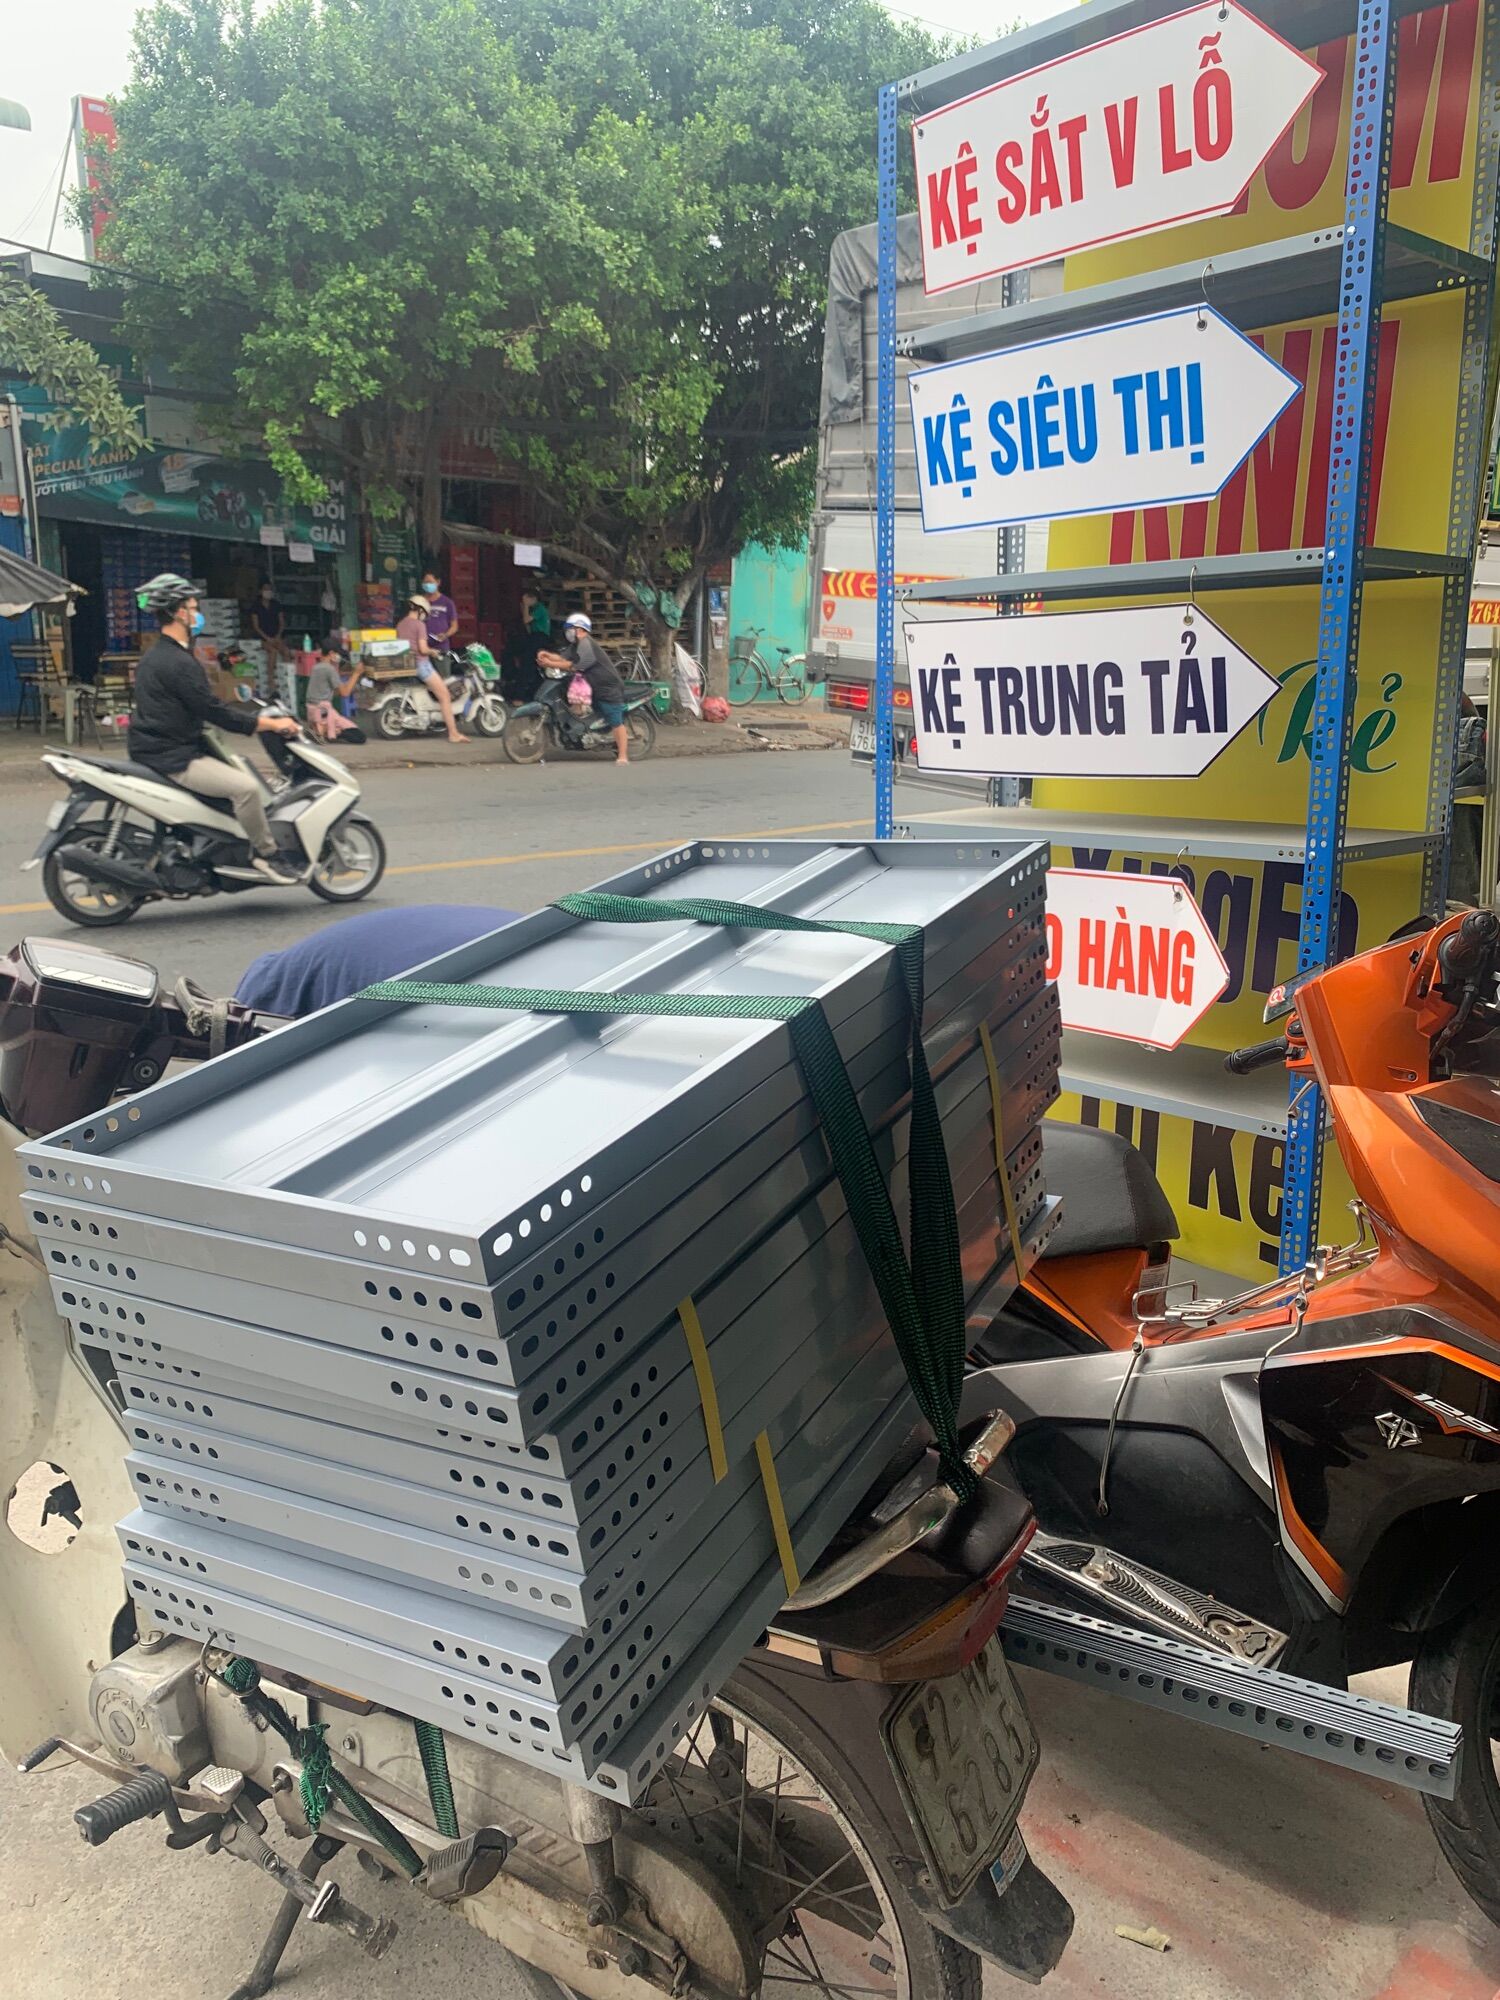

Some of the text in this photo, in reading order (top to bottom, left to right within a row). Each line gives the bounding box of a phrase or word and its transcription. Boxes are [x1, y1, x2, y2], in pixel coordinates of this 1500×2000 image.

[928, 32, 1233, 255] KỆ SẮT V LỖ
[33, 458, 84, 477] PECIAL
[922, 362, 1205, 498] KỆ SIÊU THỊ
[918, 630, 1228, 750] KỆ TRUNG TẢI
[1078, 906, 1196, 1007] HÀNG
[1414, 1393, 1499, 1433] 125
[945, 1699, 1025, 1857] 6285
